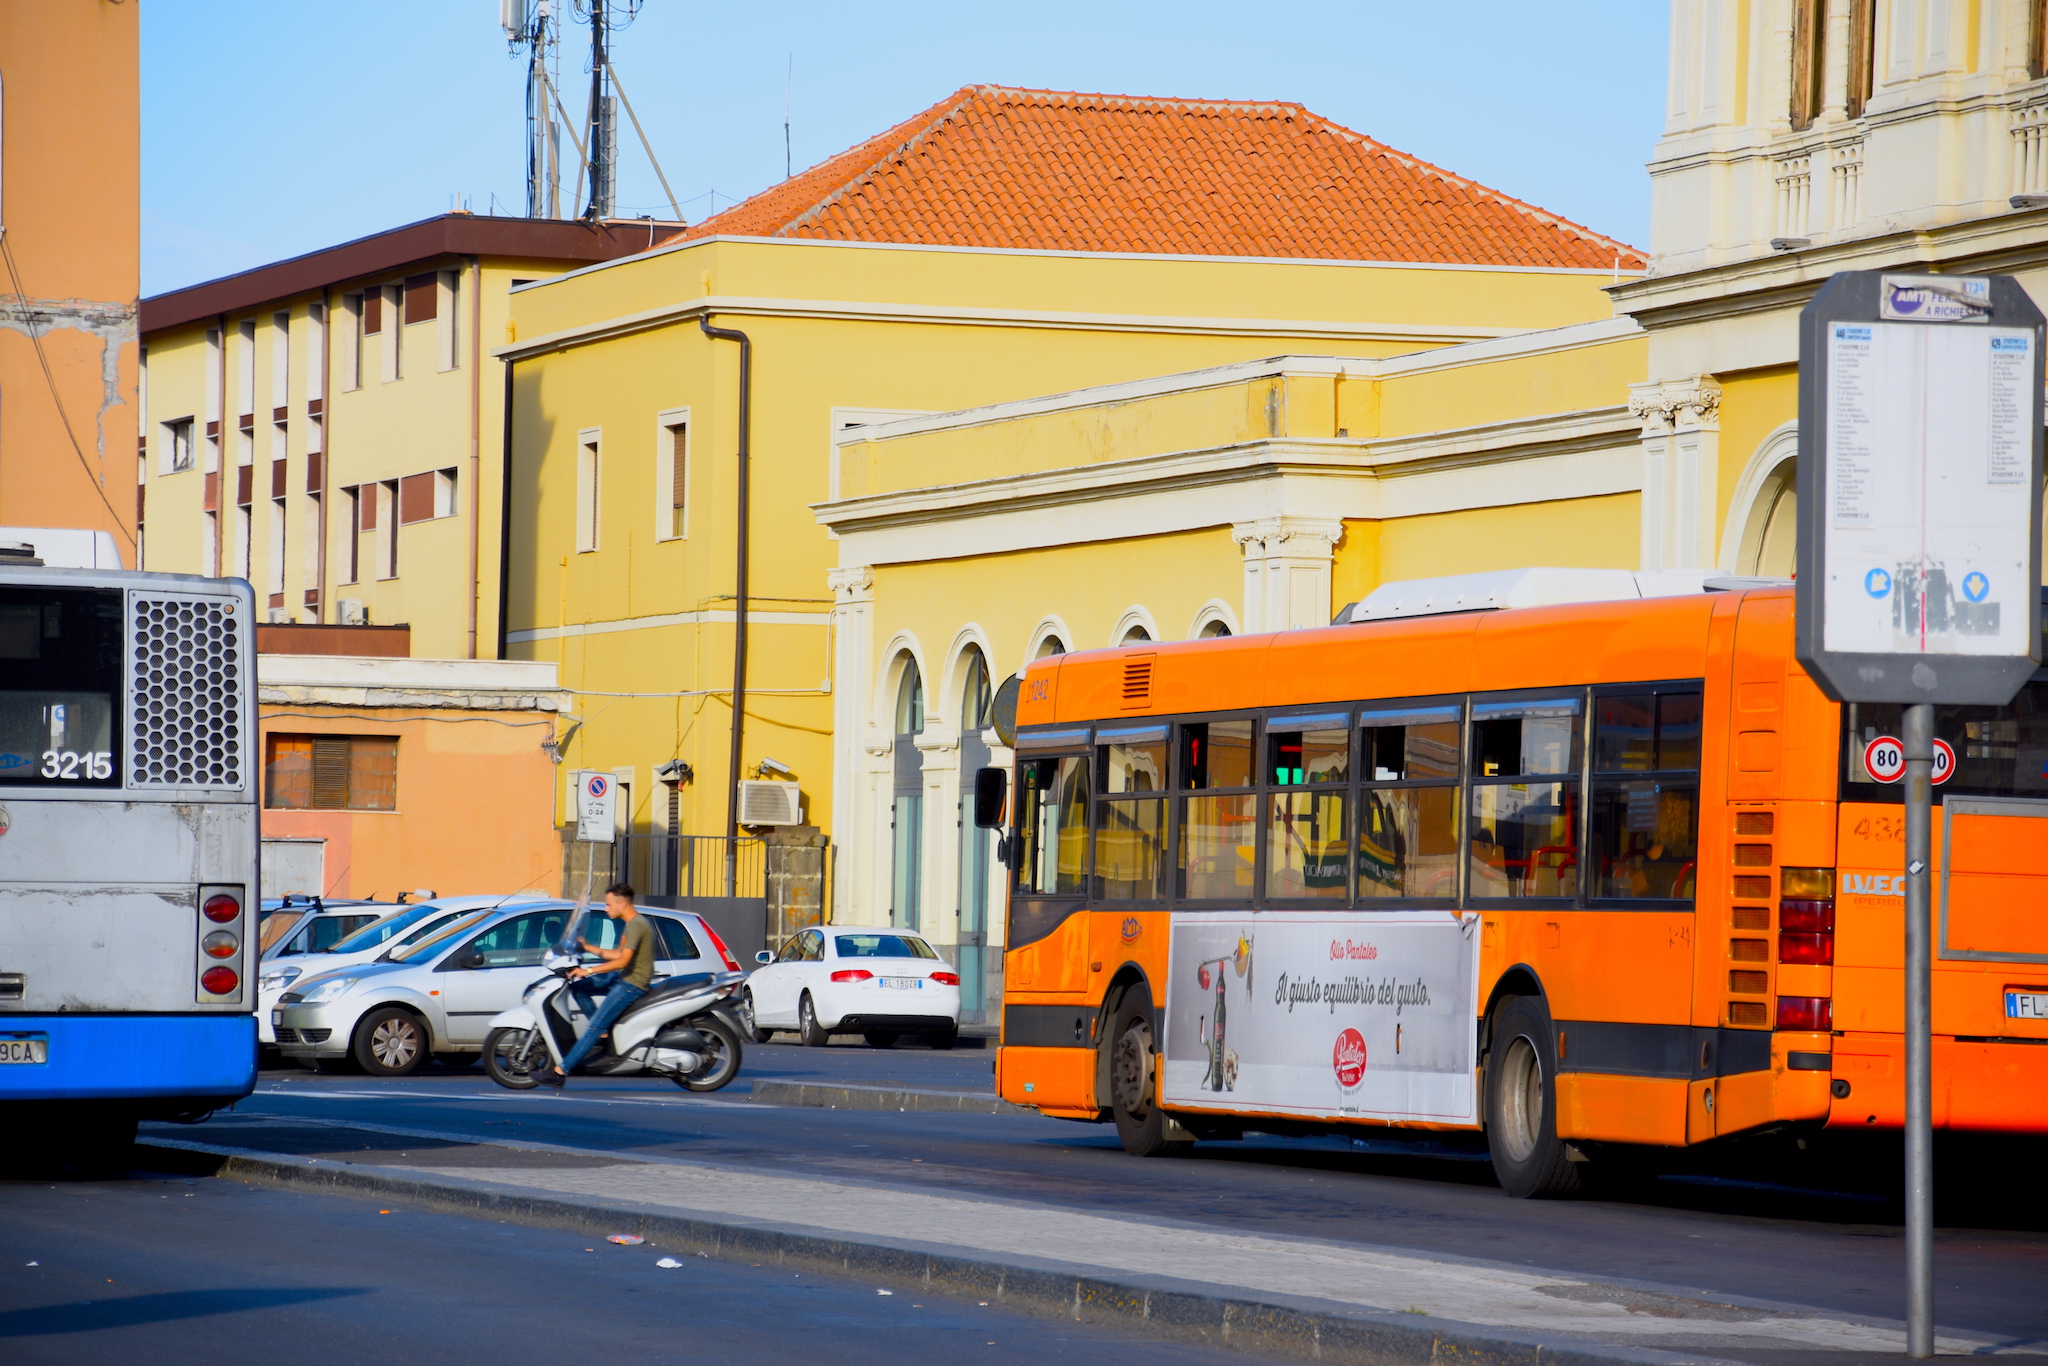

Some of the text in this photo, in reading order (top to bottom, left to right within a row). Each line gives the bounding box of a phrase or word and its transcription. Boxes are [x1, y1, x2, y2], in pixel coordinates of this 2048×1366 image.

[1896, 288, 1925, 302] AMT
[1925, 306, 1931, 316] A
[1032, 679, 1049, 701] 1242
[41, 751, 112, 779] 3215
[1877, 749, 1898, 767] 80
[1842, 873, 1906, 896] IVEC
[1330, 938, 1378, 961] Olio Pantaleo
[884, 979, 893, 988] EL
[1275, 971, 1431, 1017] Il giusto equilibrio del gusto.
[2020, 996, 2044, 1016] FL
[0, 1043, 33, 1062] 9CA
[1336, 1033, 1365, 1067] Pantaleo
